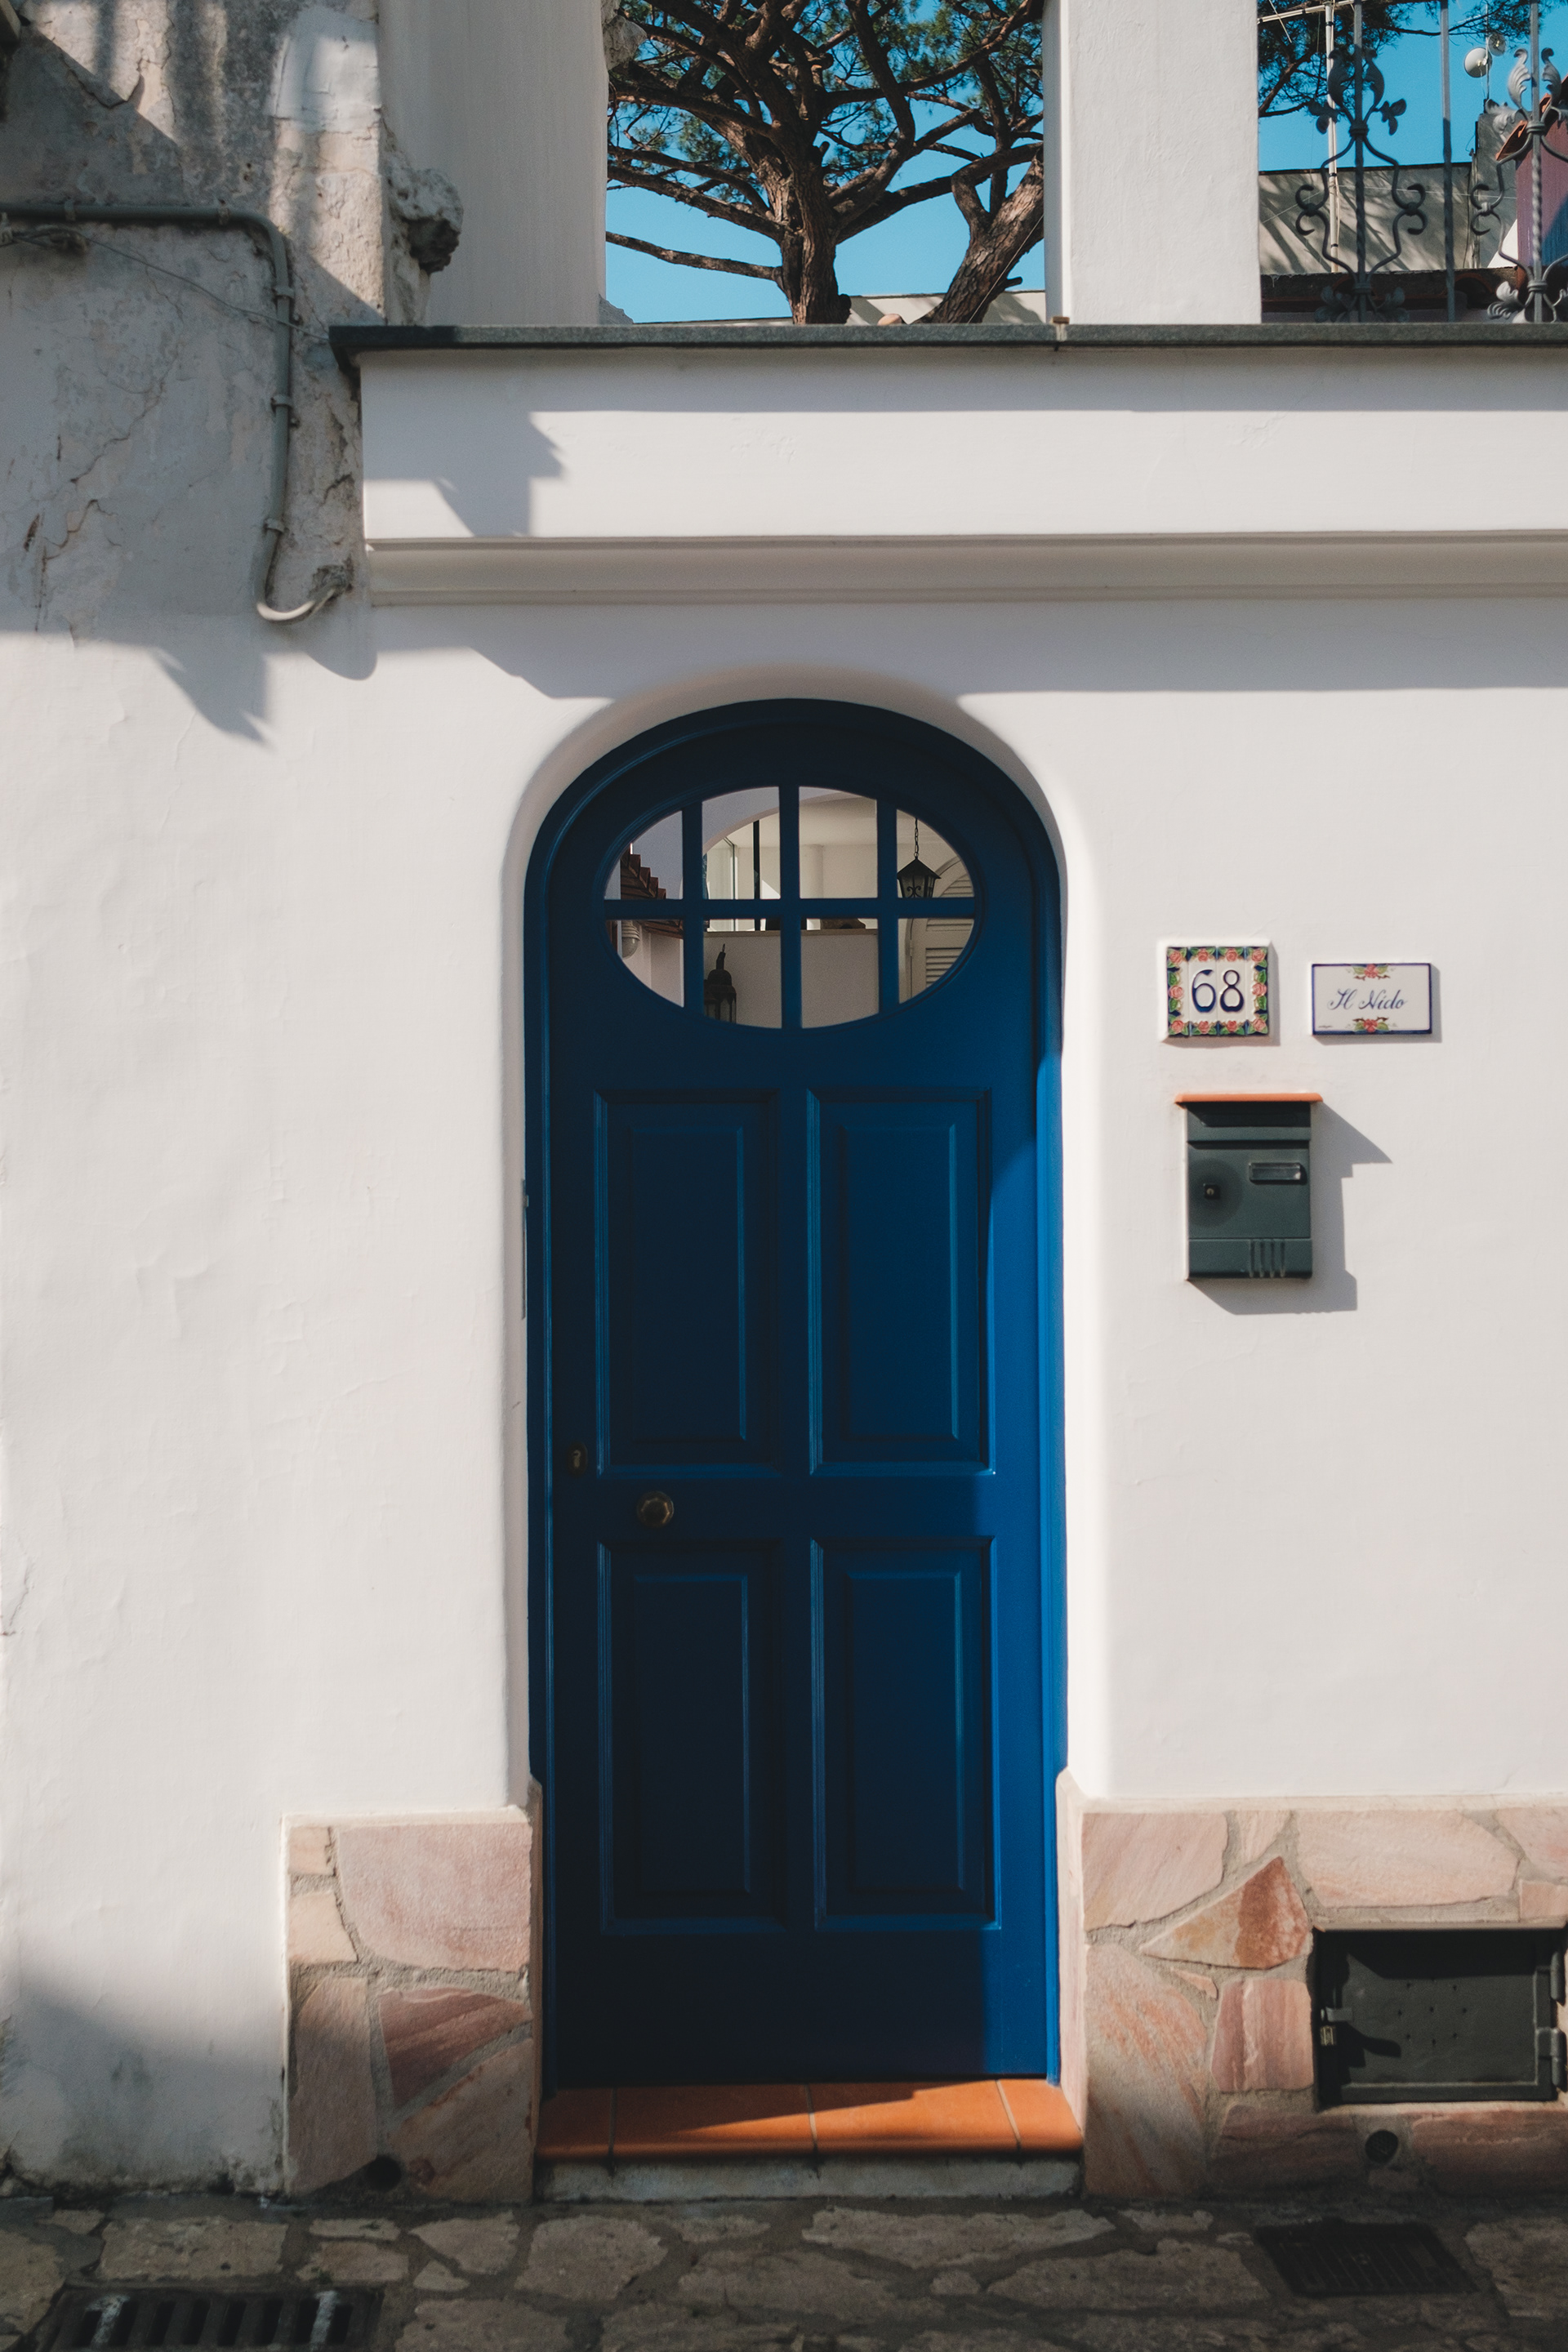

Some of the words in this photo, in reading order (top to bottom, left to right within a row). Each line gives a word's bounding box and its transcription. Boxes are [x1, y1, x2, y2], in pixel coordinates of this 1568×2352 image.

[1192, 969, 1245, 1013] 68
[1327, 988, 1357, 1010] Il
[1358, 989, 1407, 1009] Nido
